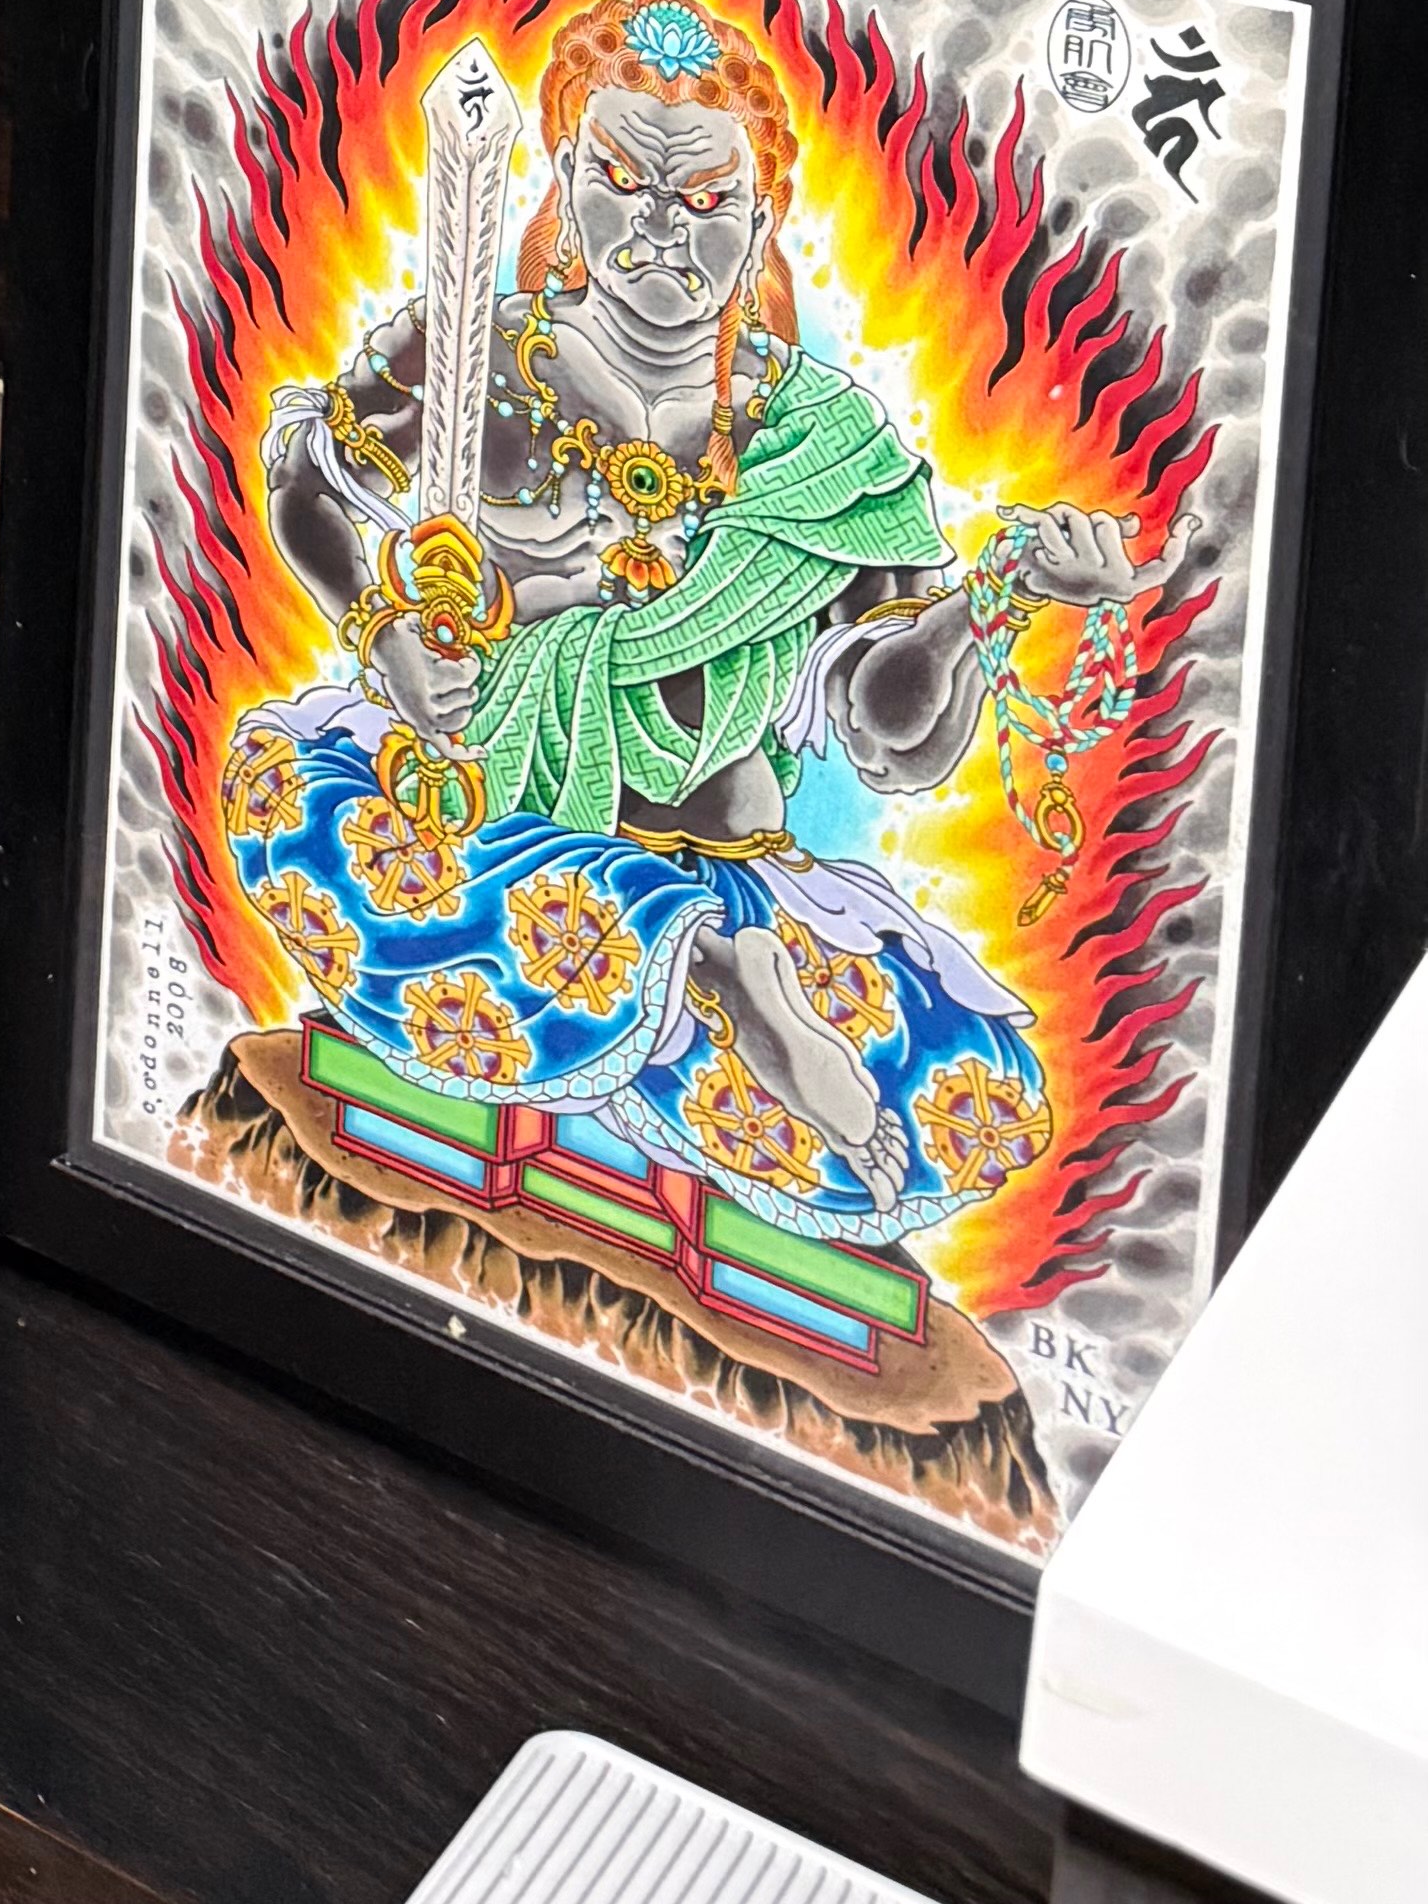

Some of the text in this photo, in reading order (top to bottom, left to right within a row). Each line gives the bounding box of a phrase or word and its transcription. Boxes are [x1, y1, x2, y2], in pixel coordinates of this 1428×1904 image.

[166, 956, 191, 1041] 2008
[1028, 1320, 1098, 1379] BK
[1060, 1379, 1131, 1436] NY
